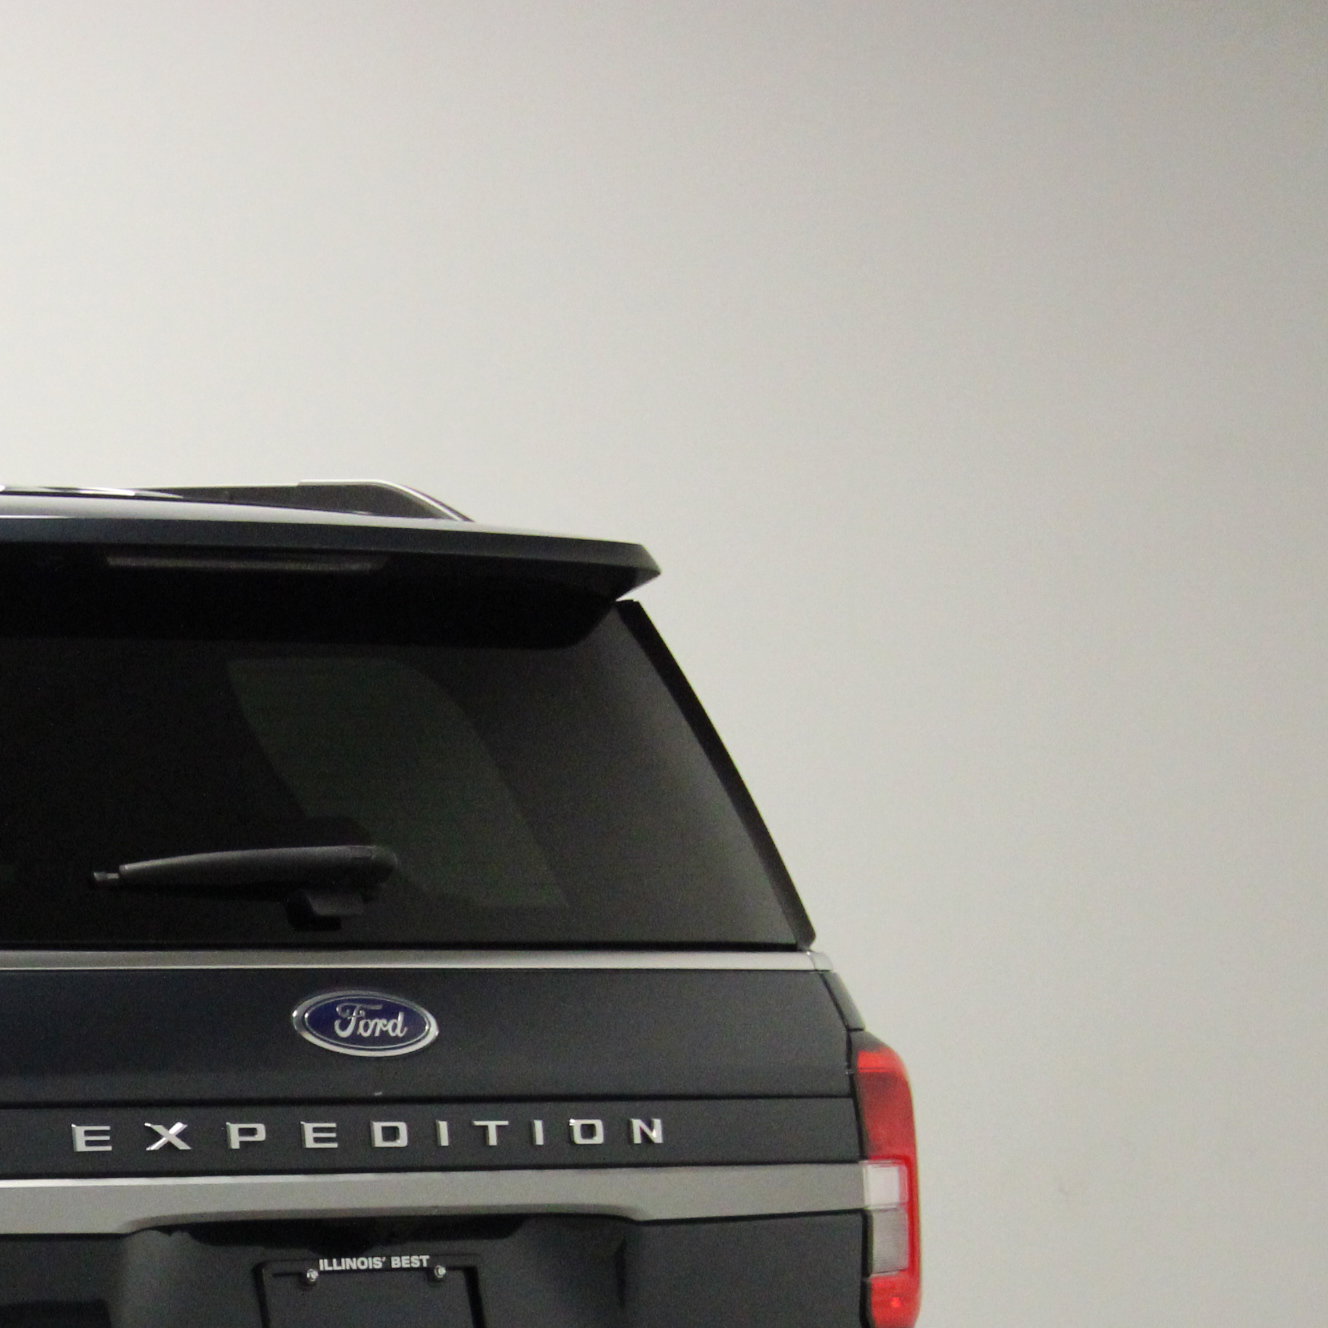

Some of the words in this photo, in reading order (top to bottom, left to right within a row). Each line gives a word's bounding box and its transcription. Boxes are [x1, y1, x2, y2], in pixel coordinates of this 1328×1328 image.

[334, 1002, 408, 1040] Ford
[71, 1117, 664, 1152] EXPEDITION
[391, 1255, 430, 1269] BEST
